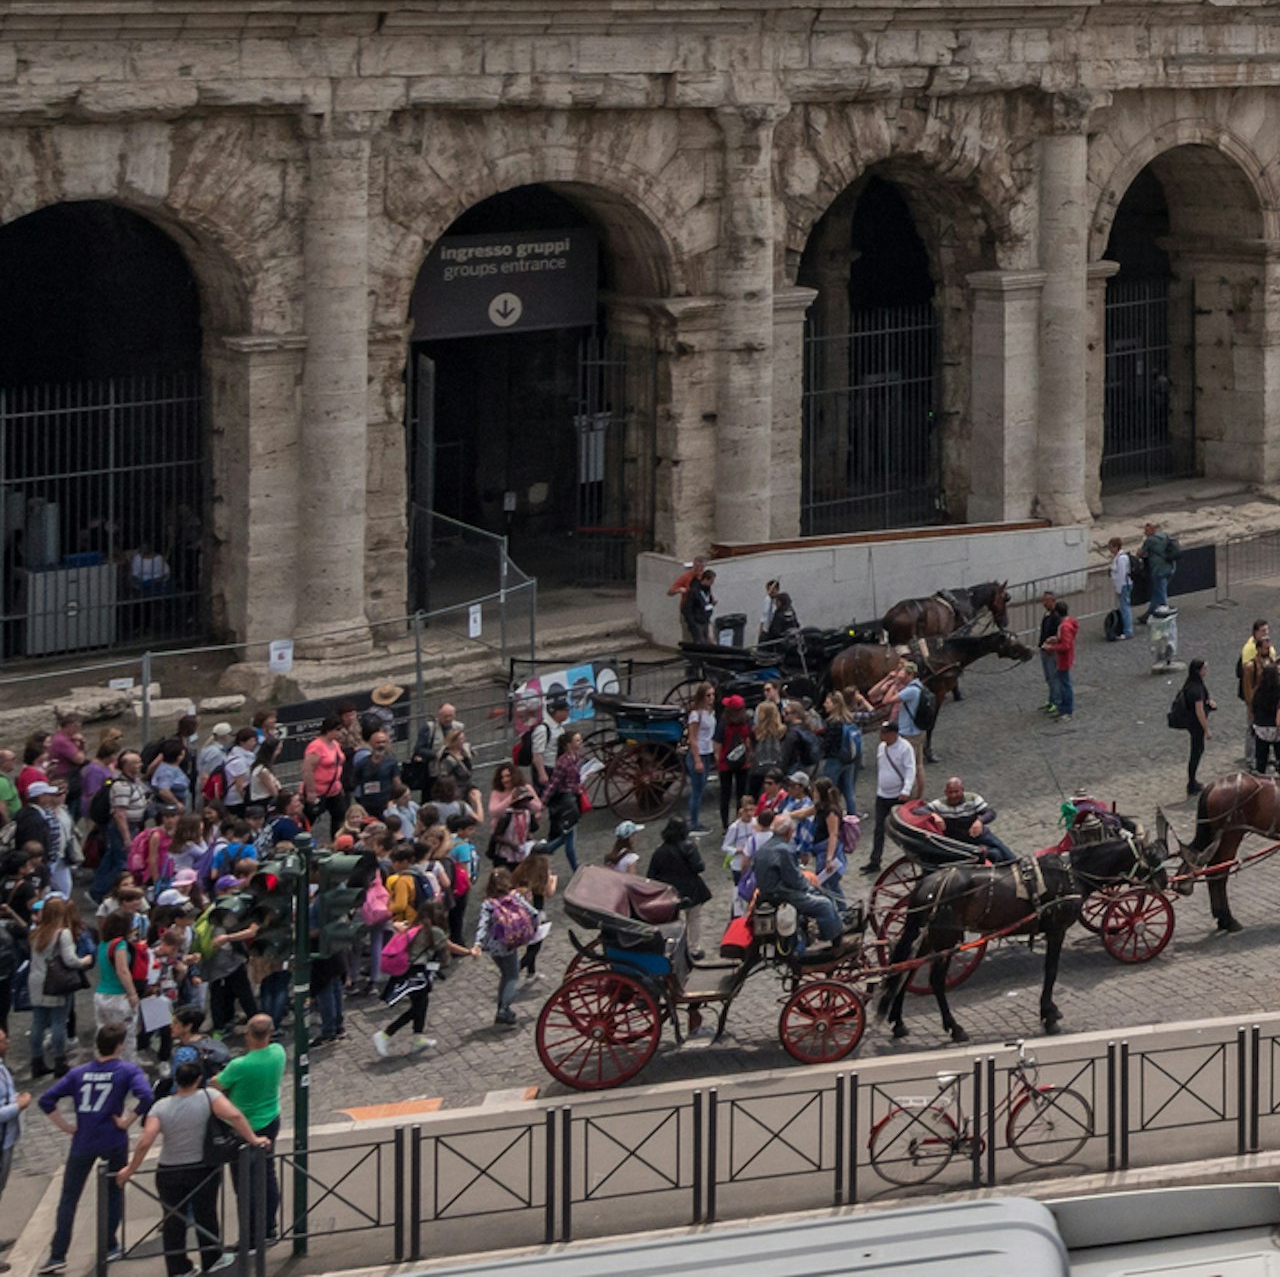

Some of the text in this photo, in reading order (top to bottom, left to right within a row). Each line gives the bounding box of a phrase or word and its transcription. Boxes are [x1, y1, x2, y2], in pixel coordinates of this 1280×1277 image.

[441, 237, 571, 262] ingresso gruppi
[443, 257, 567, 281] groups entrance
[79, 1083, 113, 1112] 17
